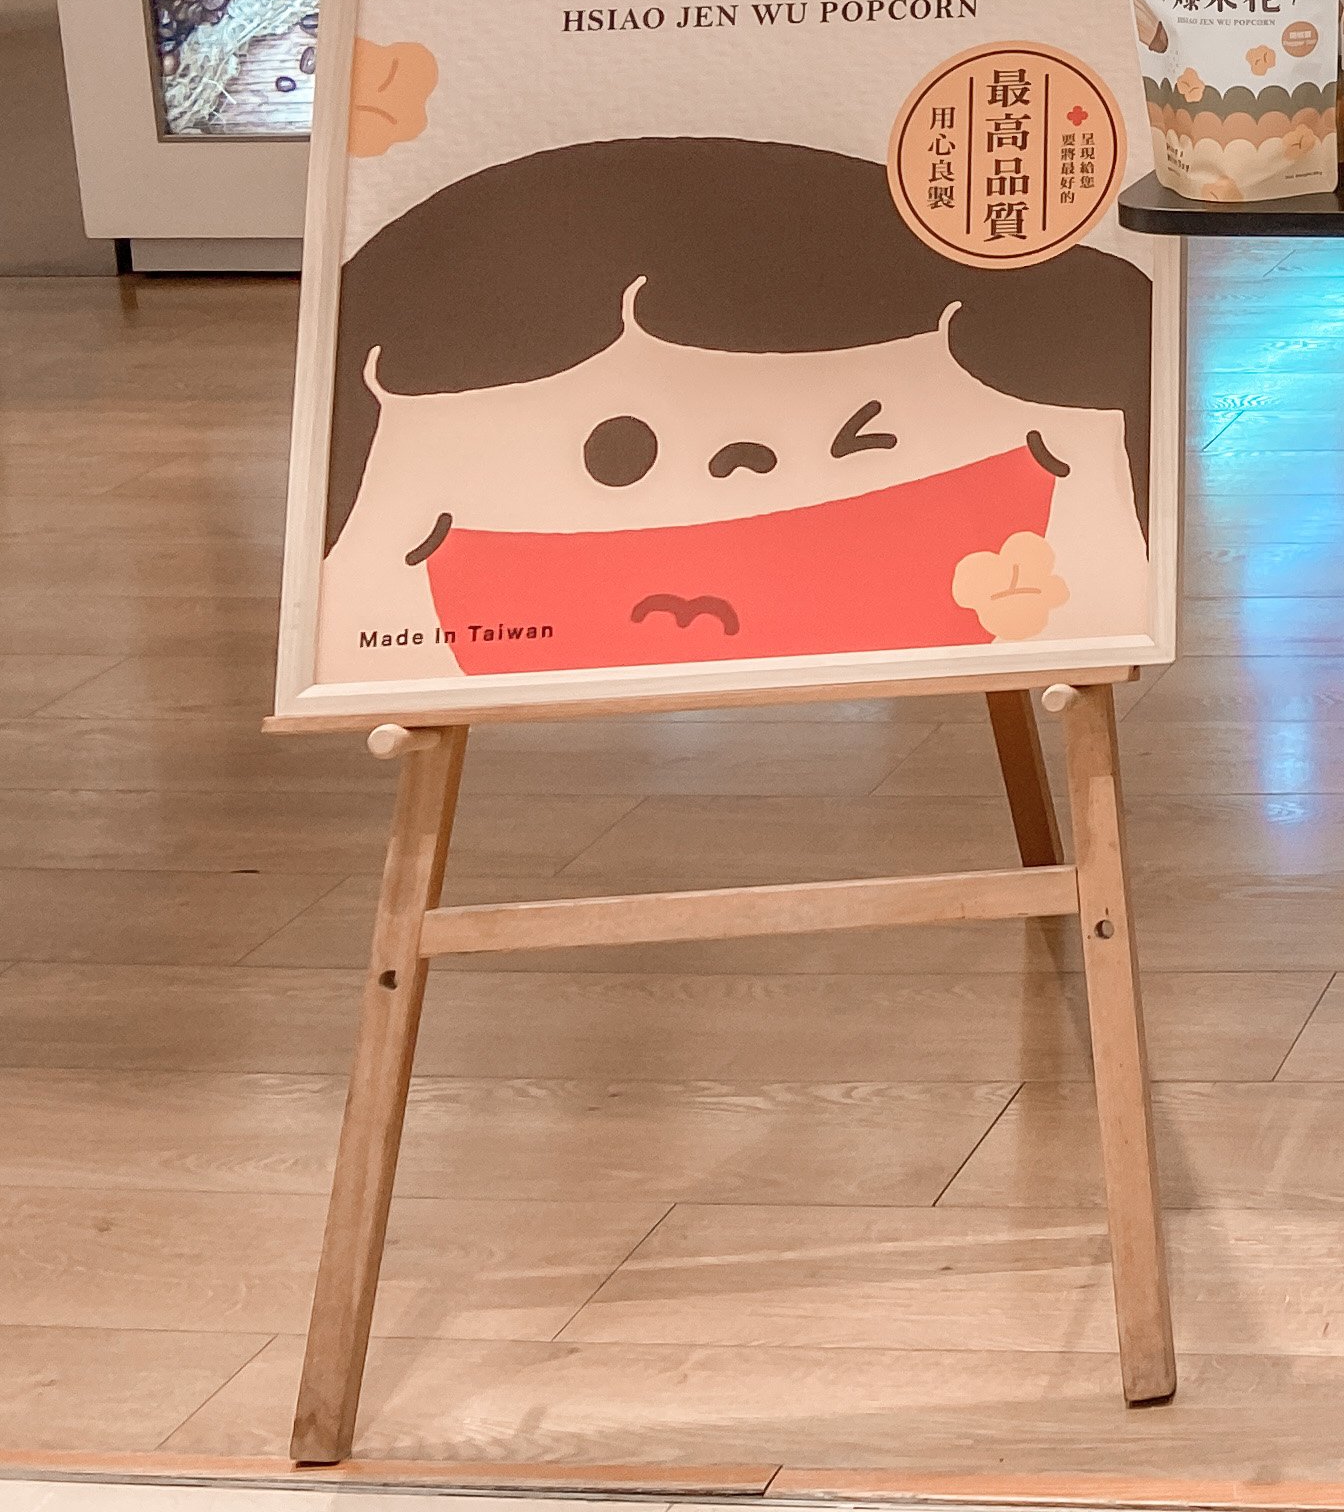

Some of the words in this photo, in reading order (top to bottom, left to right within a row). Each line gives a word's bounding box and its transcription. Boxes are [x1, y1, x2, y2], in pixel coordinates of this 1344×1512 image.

[562, 4, 666, 34] HSIAO
[676, 2, 739, 30] JEN
[751, 0, 809, 28] WU
[1216, 18, 1231, 26] WU
[1233, 18, 1276, 26] POPCORN
[927, 105, 957, 211] 用心良製
[983, 68, 1032, 243] 最高品質
[1060, 133, 1076, 205] 要將最好的
[1079, 132, 1096, 189] 呈現給您
[359, 628, 423, 649] Made
[434, 626, 457, 644] In
[468, 621, 555, 643] Taiwan
